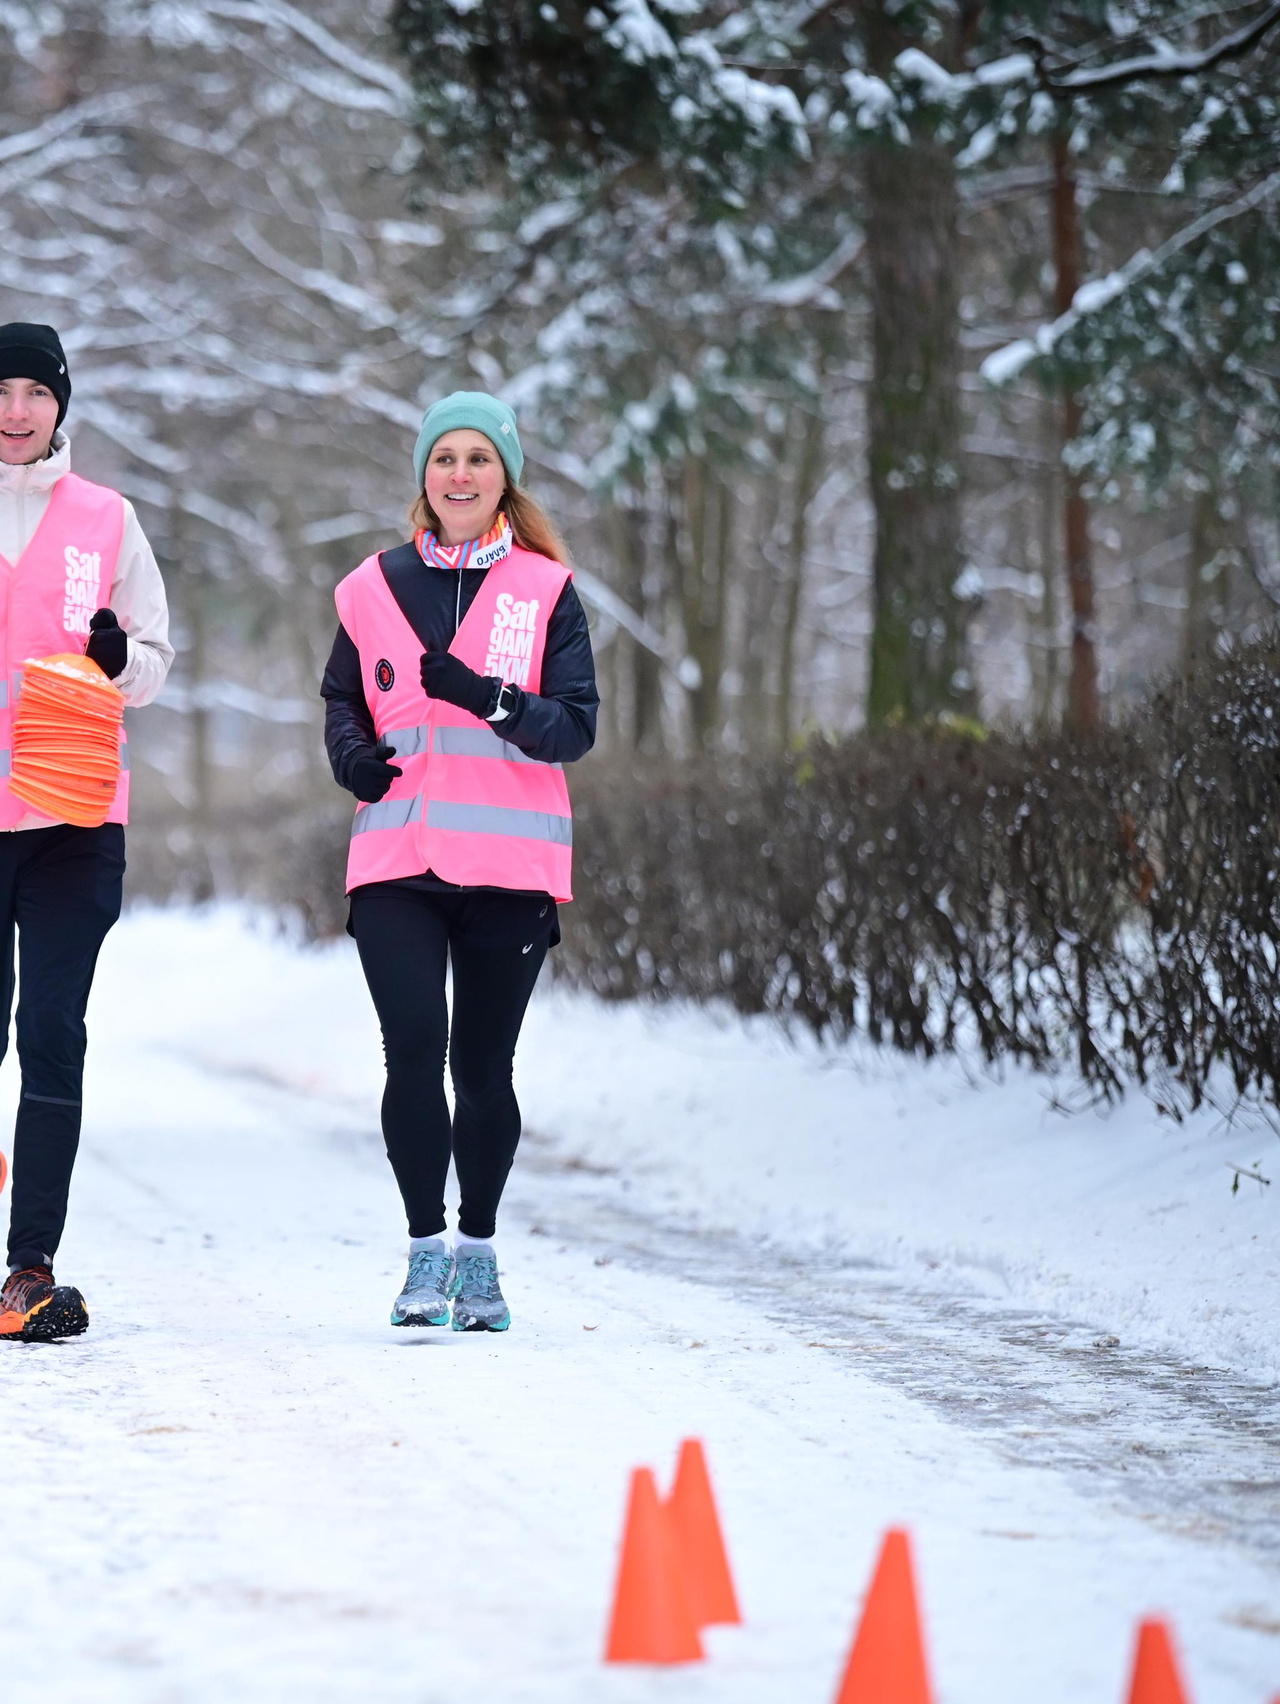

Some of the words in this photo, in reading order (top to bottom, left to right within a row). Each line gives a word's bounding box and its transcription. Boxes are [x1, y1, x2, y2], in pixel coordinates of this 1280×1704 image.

[64, 546, 101, 583] Sat
[477, 545, 506, 566] БЛАГО
[64, 579, 99, 609] 9AM
[493, 593, 539, 631] Sat
[488, 627, 535, 659] 9AM
[484, 653, 530, 686] 5KM
